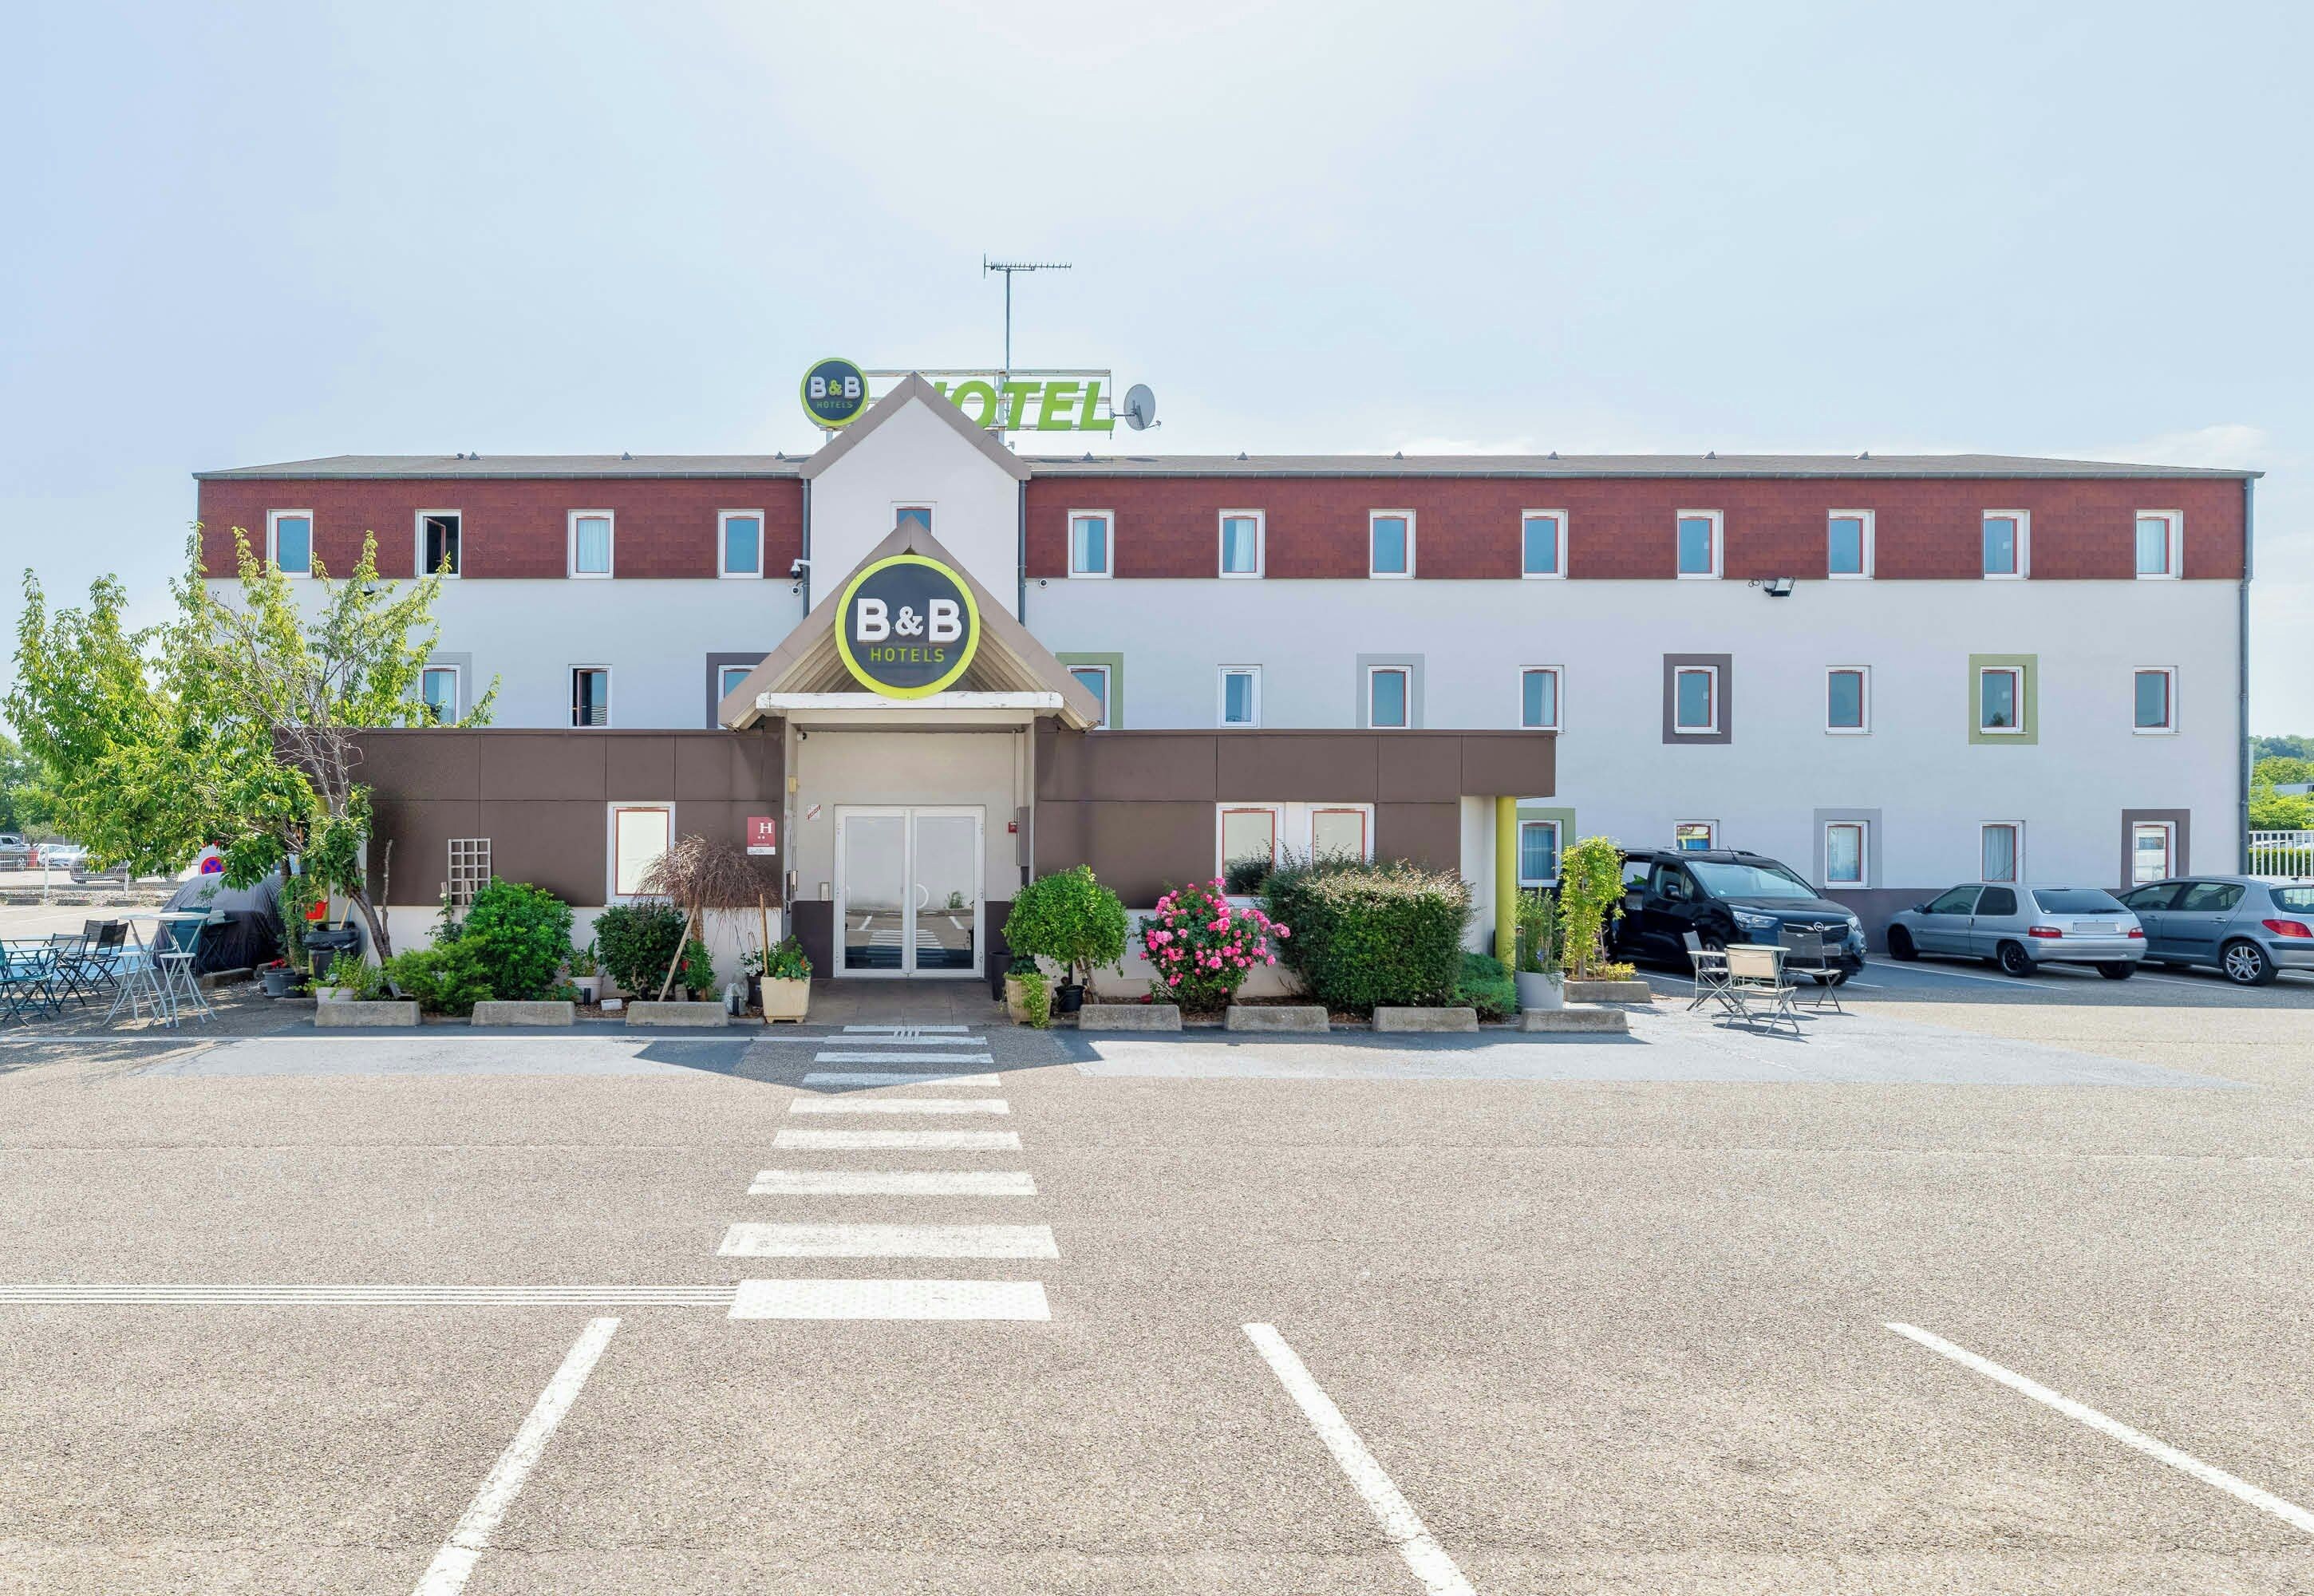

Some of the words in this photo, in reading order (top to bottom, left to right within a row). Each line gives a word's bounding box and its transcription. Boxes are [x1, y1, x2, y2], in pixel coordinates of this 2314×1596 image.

[810, 376, 861, 399] B&B
[934, 381, 1116, 431] OTEL
[856, 598, 962, 643] B&B
[870, 647, 946, 662] HOTELS
[759, 822, 773, 834] H
